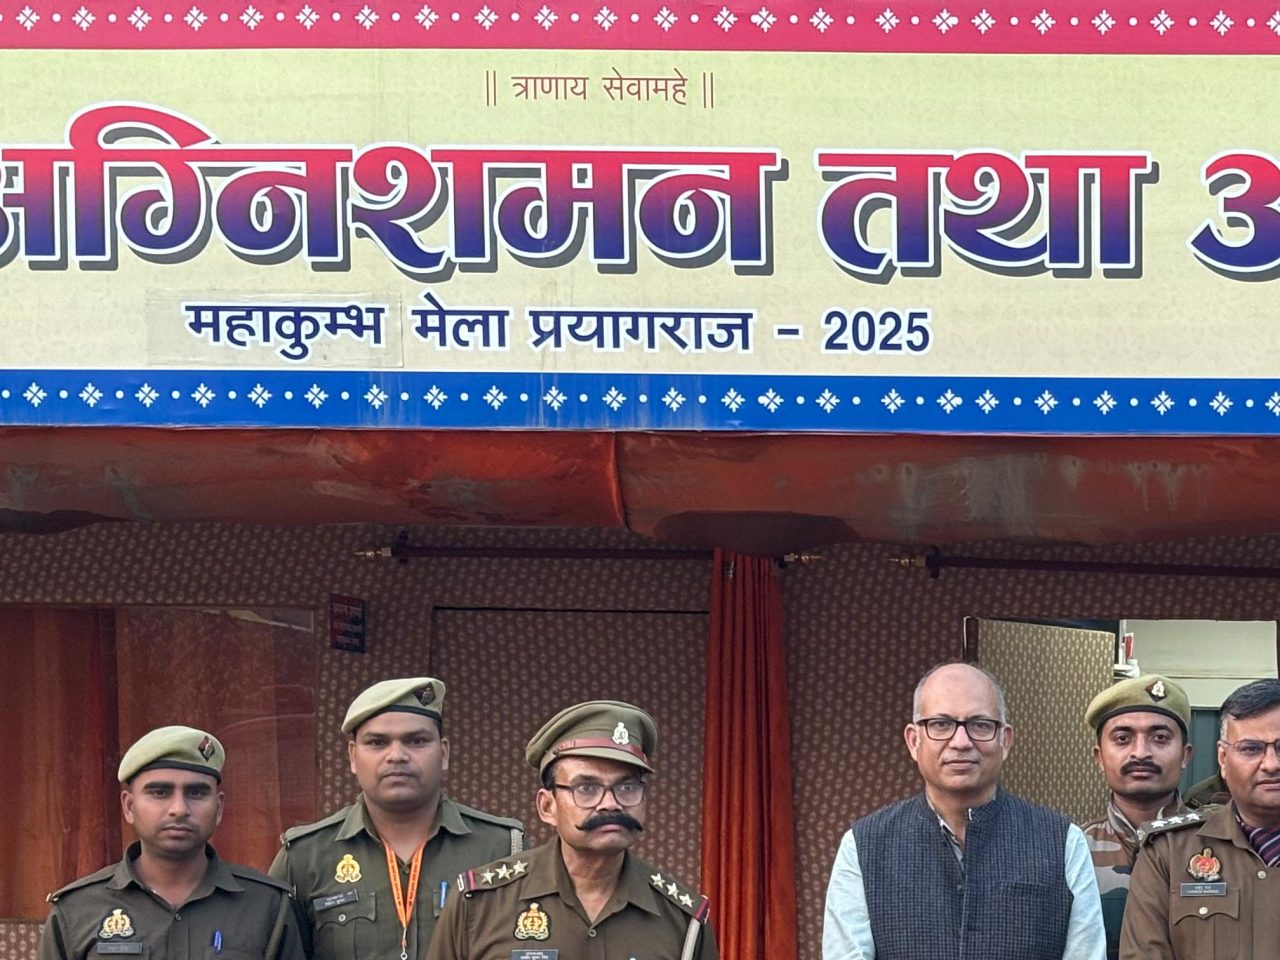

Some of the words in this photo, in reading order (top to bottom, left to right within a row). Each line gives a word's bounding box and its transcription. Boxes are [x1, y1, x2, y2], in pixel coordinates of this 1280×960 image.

[511, 76, 590, 100] त्राणाय
[602, 66, 688, 106] सेवामहे
[817, 151, 1149, 273] तथा
[185, 304, 385, 361] महाकुम्भ
[411, 291, 510, 348] मेला
[528, 309, 754, 351] प्रयागराज
[824, 310, 930, 352] 2025
